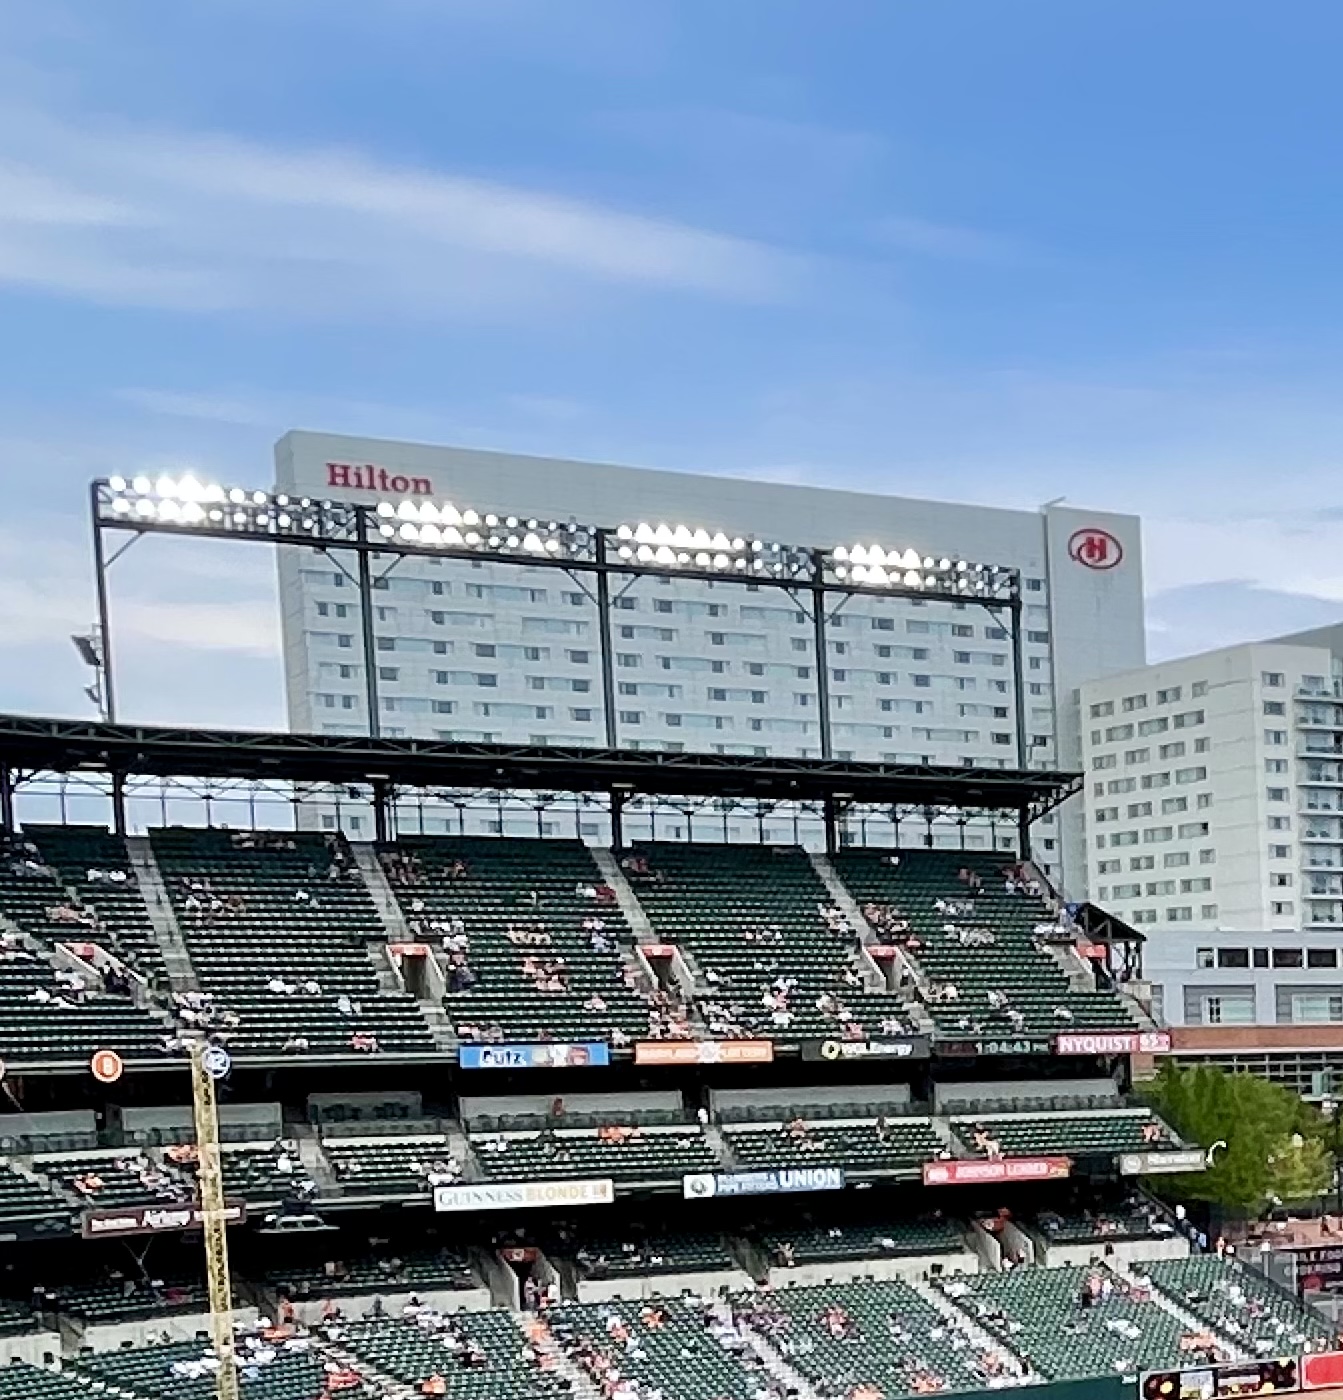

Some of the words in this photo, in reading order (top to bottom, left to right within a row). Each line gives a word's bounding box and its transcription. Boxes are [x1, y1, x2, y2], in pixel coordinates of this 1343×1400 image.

[326, 462, 434, 495] Hilton
[1058, 1035, 1132, 1053] NYQUIST
[779, 1168, 841, 1188] UNION
[439, 1190, 523, 1206] GUINNESS
[525, 1184, 586, 1201] BLONDE
